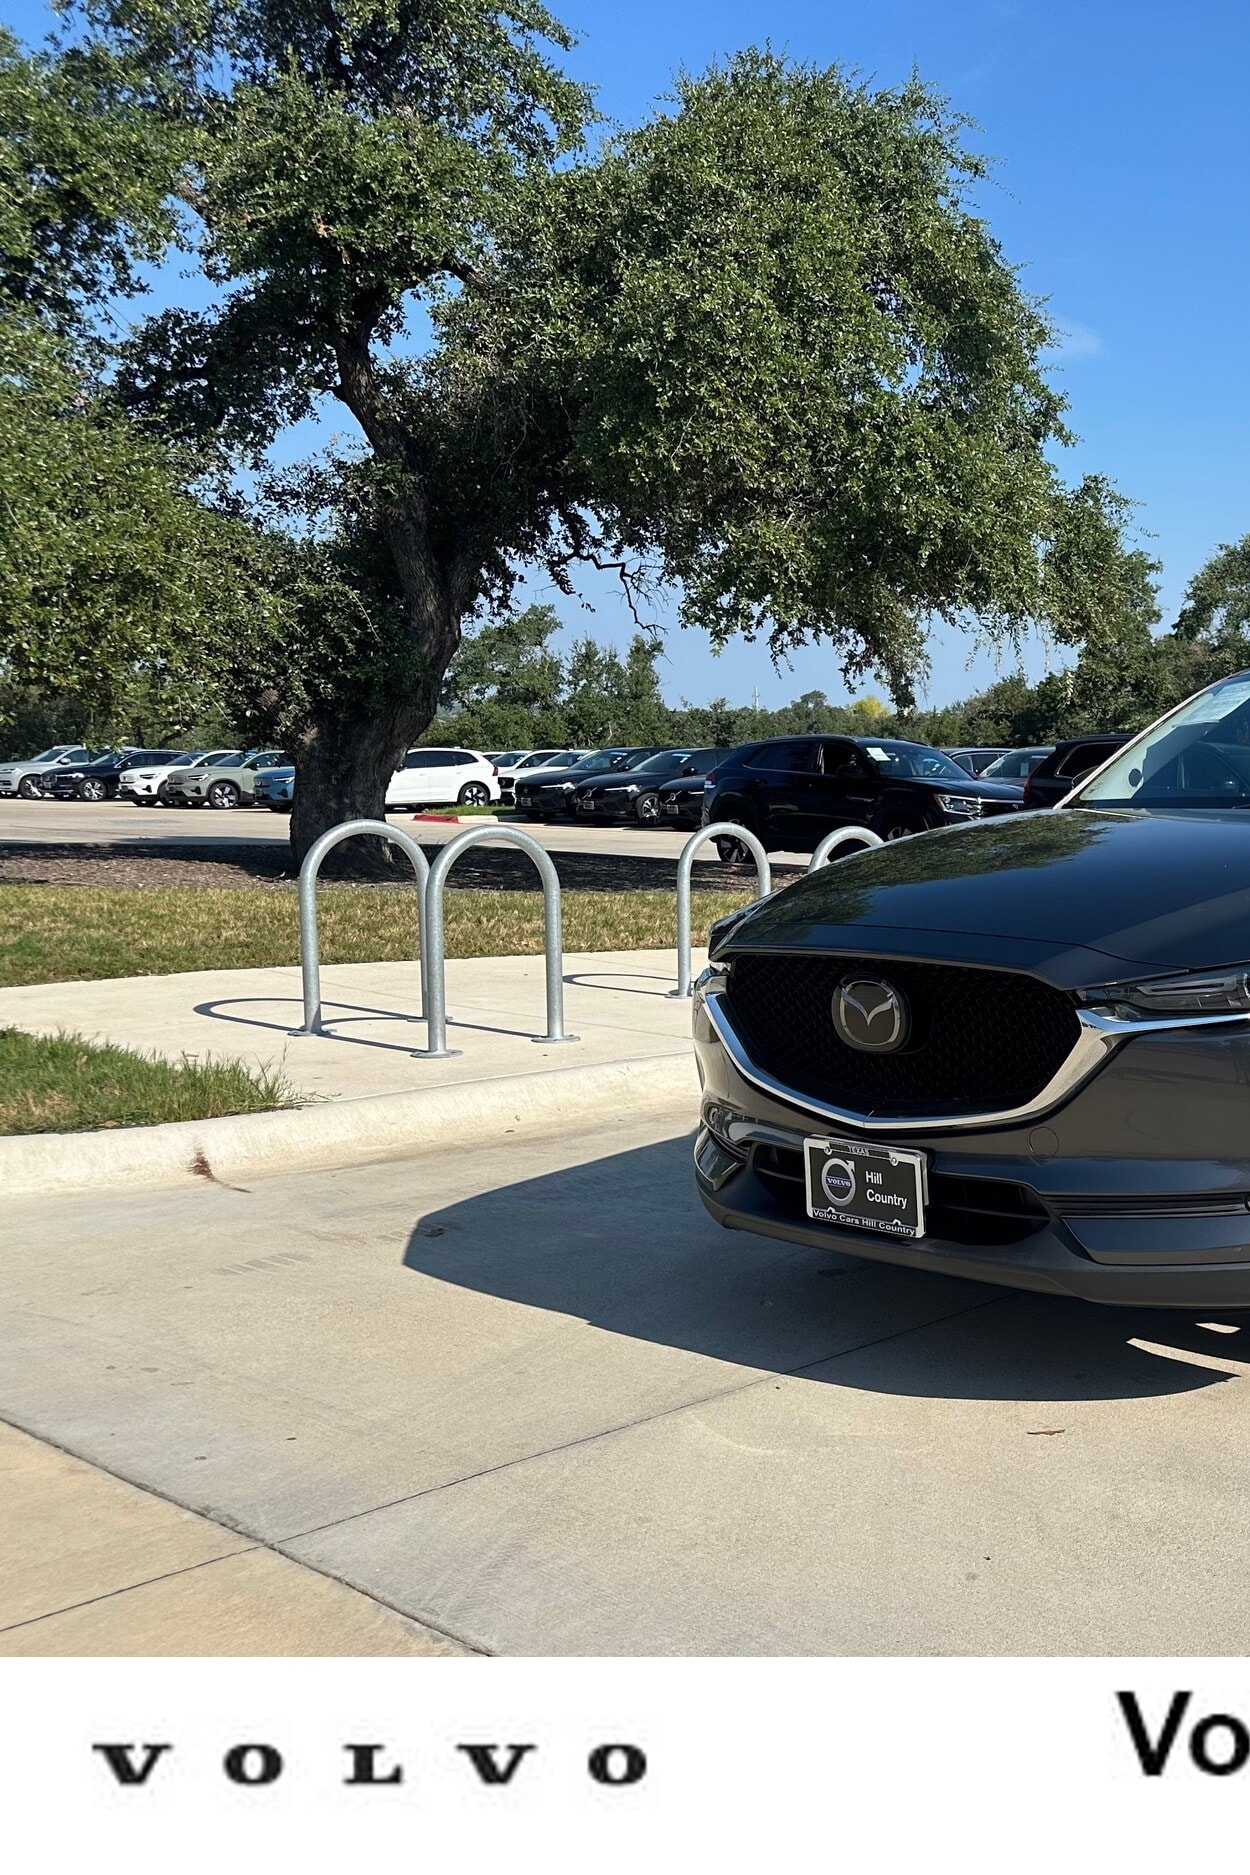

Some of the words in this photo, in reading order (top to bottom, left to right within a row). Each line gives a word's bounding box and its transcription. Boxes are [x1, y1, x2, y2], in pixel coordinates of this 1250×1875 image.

[848, 1145, 870, 1156] TEXAS
[826, 1177, 851, 1187] VOLVO
[865, 1170, 882, 1185] Hill
[866, 1189, 907, 1210] Country
[813, 1209, 837, 1220] Volvo
[839, 1214, 860, 1225] Cars
[861, 1218, 877, 1228] Hill
[878, 1222, 915, 1236] Country
